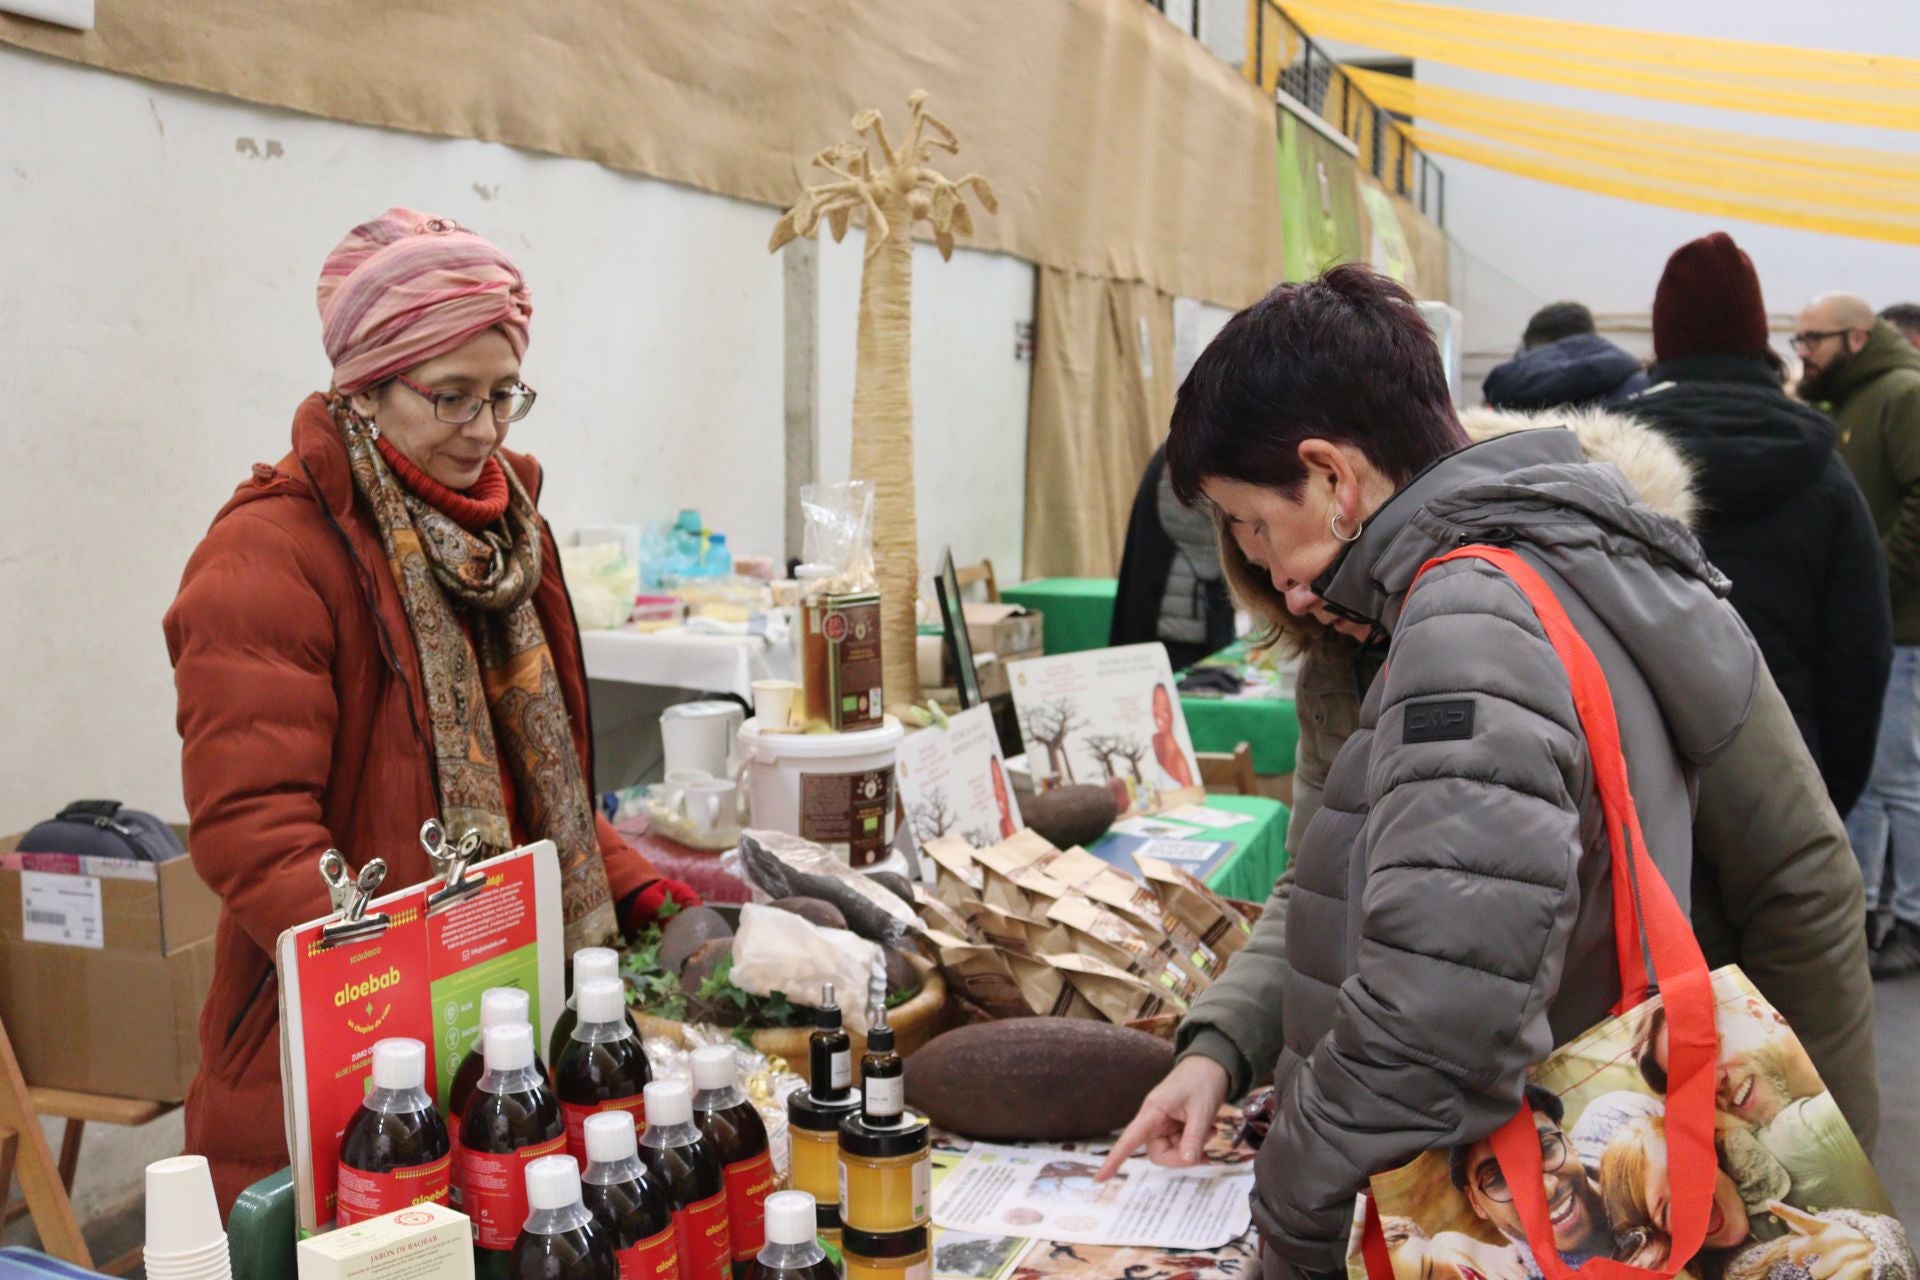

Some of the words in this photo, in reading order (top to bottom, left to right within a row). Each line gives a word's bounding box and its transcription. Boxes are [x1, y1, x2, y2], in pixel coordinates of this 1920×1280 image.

[1409, 707, 1466, 730] CMP
[334, 965, 401, 1007] aloebab
[351, 1048, 368, 1062] ZUMO
[370, 1248, 395, 1264] JABÓN
[396, 1245, 407, 1254] DE
[407, 1234, 438, 1250] BAOBAB
